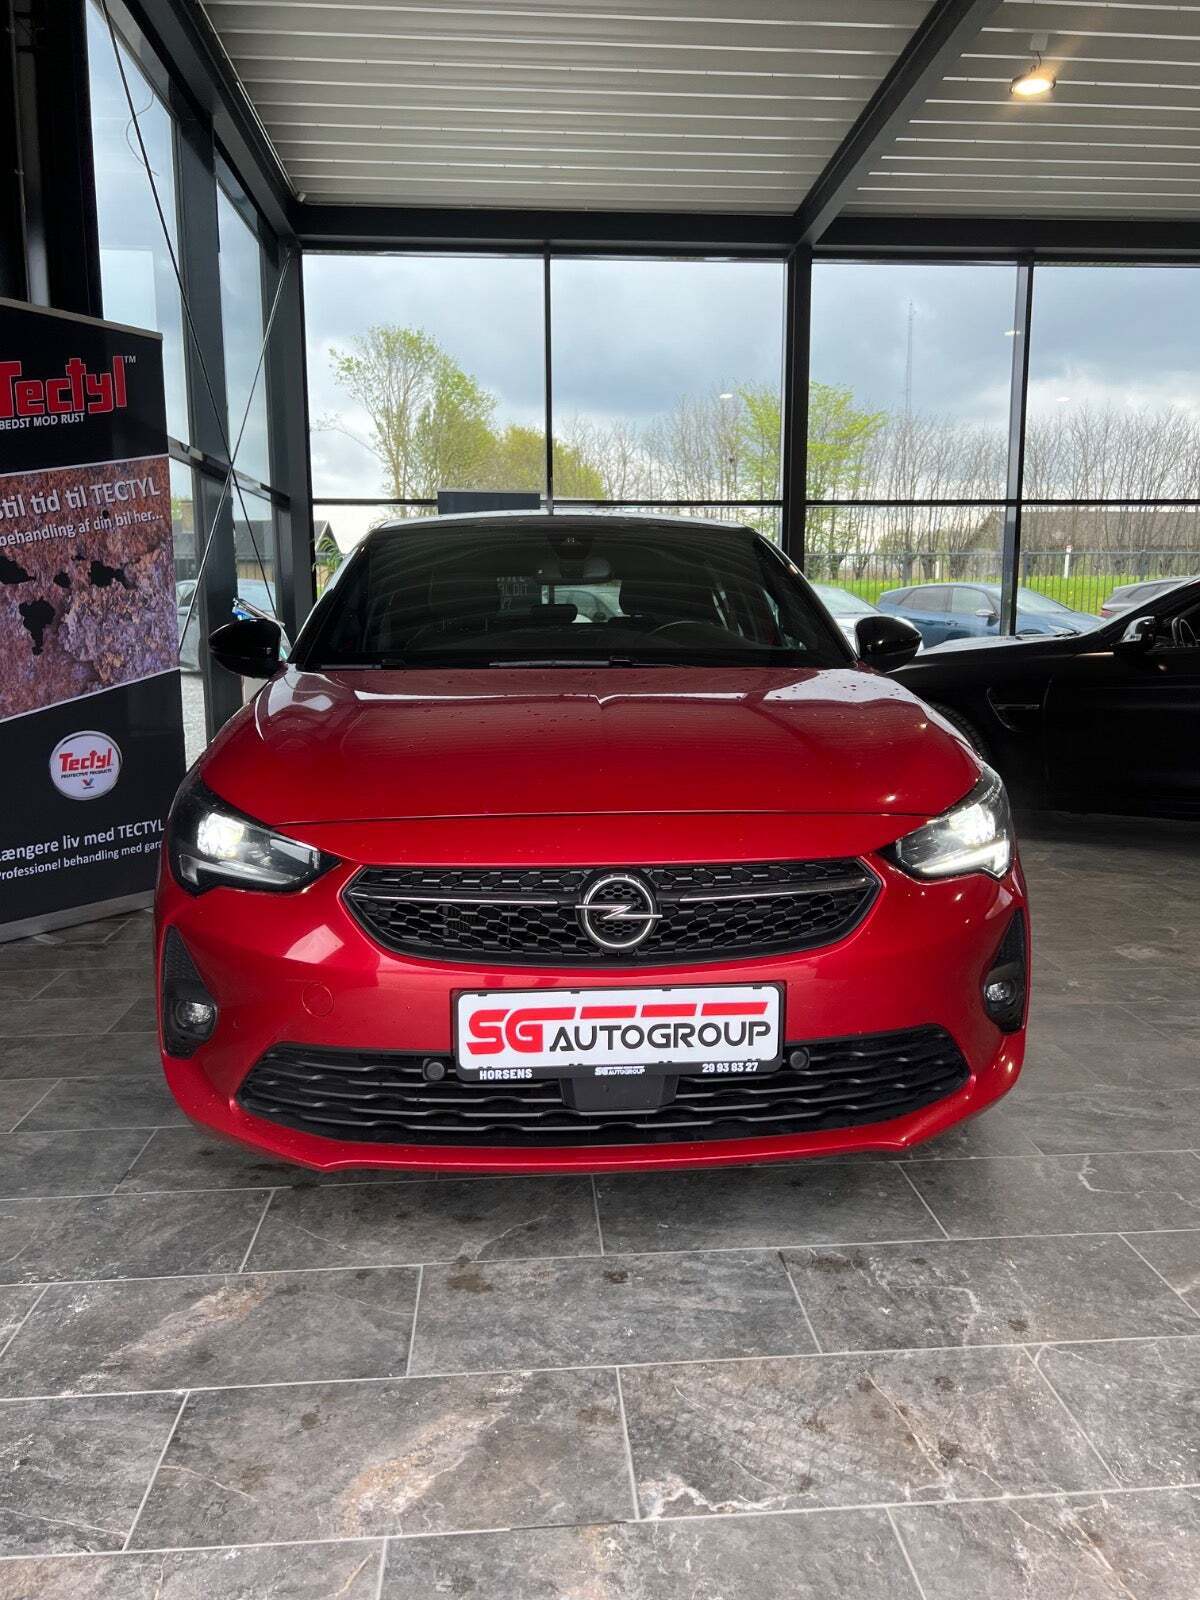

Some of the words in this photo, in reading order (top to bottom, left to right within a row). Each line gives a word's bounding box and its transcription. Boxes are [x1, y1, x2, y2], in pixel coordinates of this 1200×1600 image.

[0, 417, 31, 430] BEDST
[33, 415, 58, 427] MOD
[61, 412, 85, 424] RUST
[31, 489, 61, 514] tid
[65, 485, 87, 509] til
[90, 477, 160, 505] TECTYL
[78, 518, 90, 533] af
[94, 515, 112, 530] din
[115, 511, 131, 527] bil
[59, 747, 112, 772] Tectyl
[62, 834, 80, 850] liv
[84, 827, 115, 846] med
[117, 819, 165, 839] TECTYL
[64, 848, 119, 868] behandling
[121, 842, 142, 856] med
[549, 1021, 771, 1052] AUTOGROUP
[479, 1068, 533, 1080] HORSENS
[745, 1061, 759, 1072] 27
